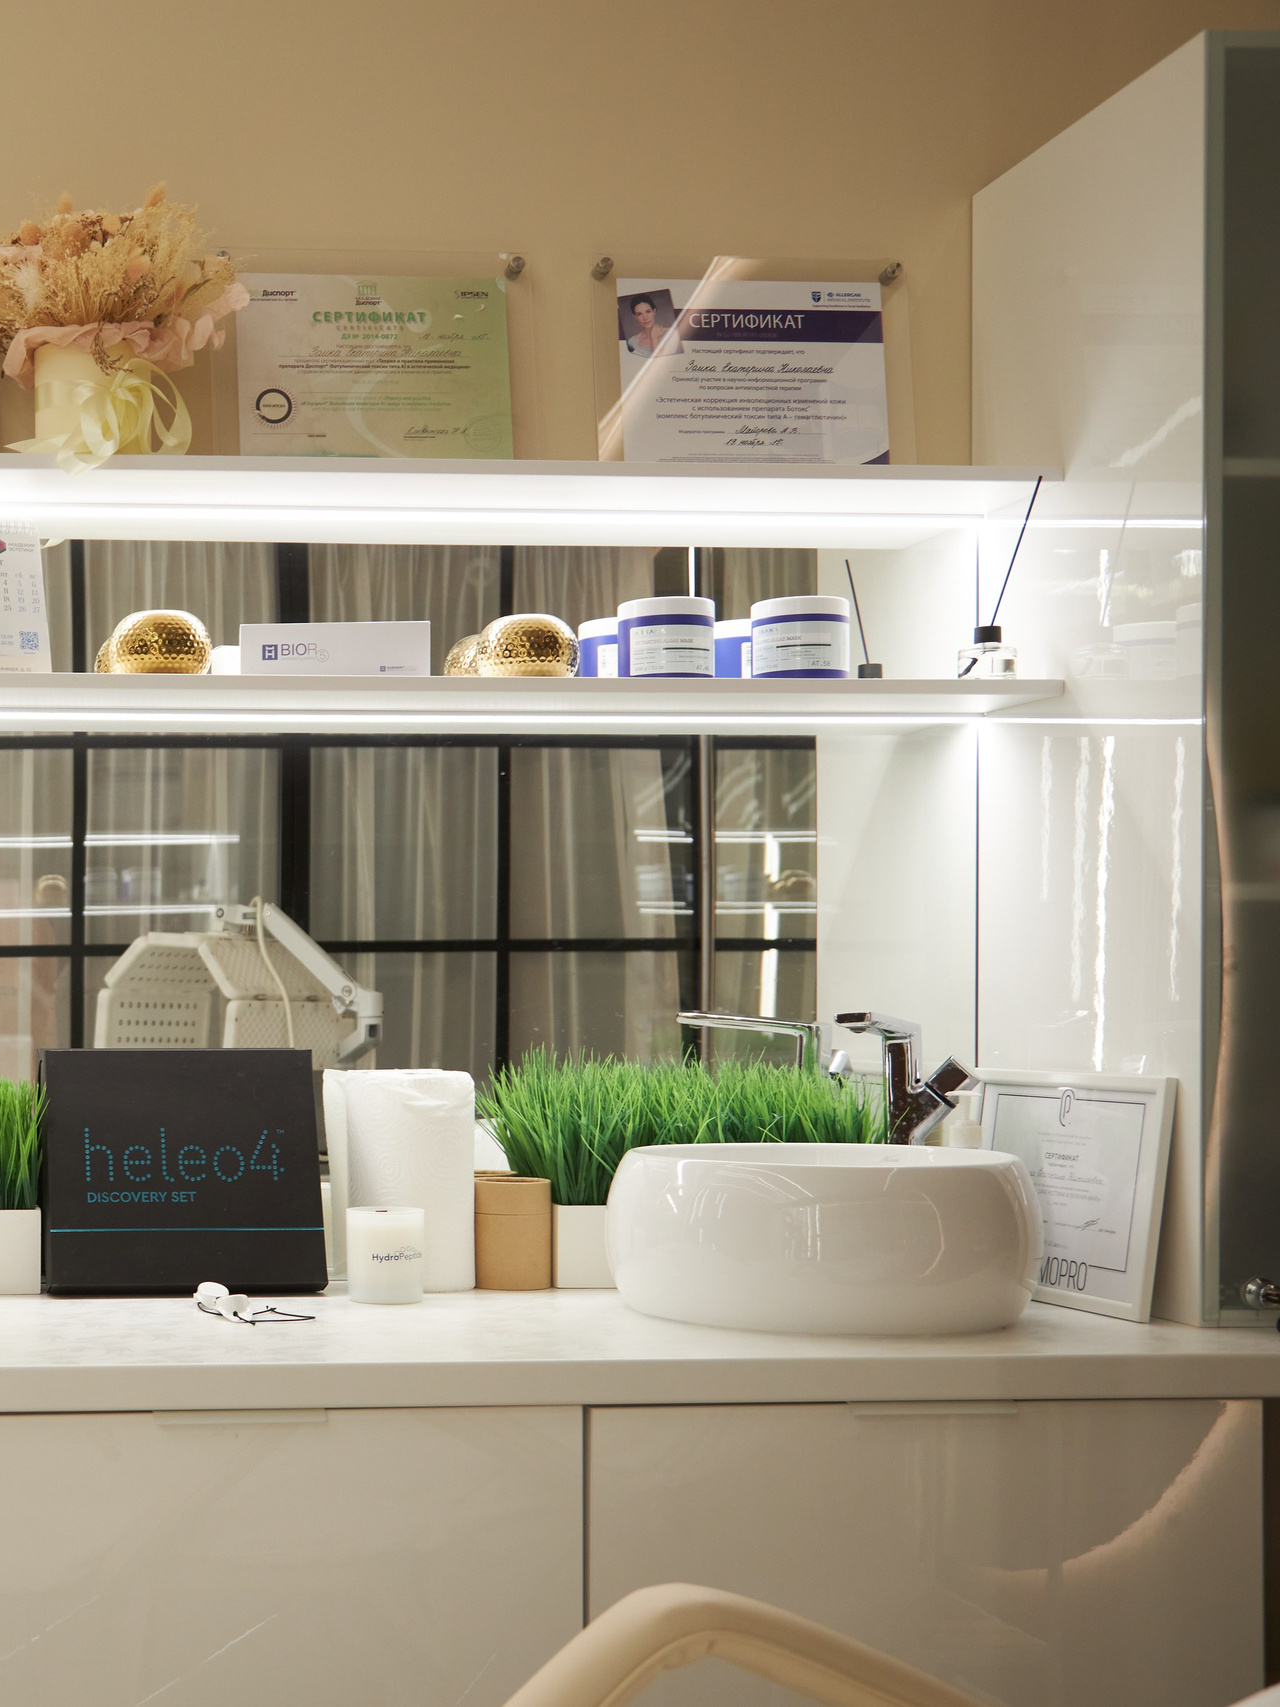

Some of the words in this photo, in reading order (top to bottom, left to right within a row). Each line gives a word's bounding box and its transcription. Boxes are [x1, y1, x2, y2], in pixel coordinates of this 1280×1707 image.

[312, 311, 426, 323] СЕРТИФИКАТ
[689, 314, 805, 329] СЕРТИФИКАТ
[685, 359, 717, 372] Заика
[721, 362, 775, 376] Екатерина
[777, 363, 834, 374] Николаевна
[689, 413, 742, 421] ботулинический
[17, 588, 24, 596] 12
[32, 606, 40, 614] 27
[84, 1127, 286, 1183] heleo4
[87, 1191, 167, 1204] DISCOVERY
[171, 1191, 197, 1203] SET
